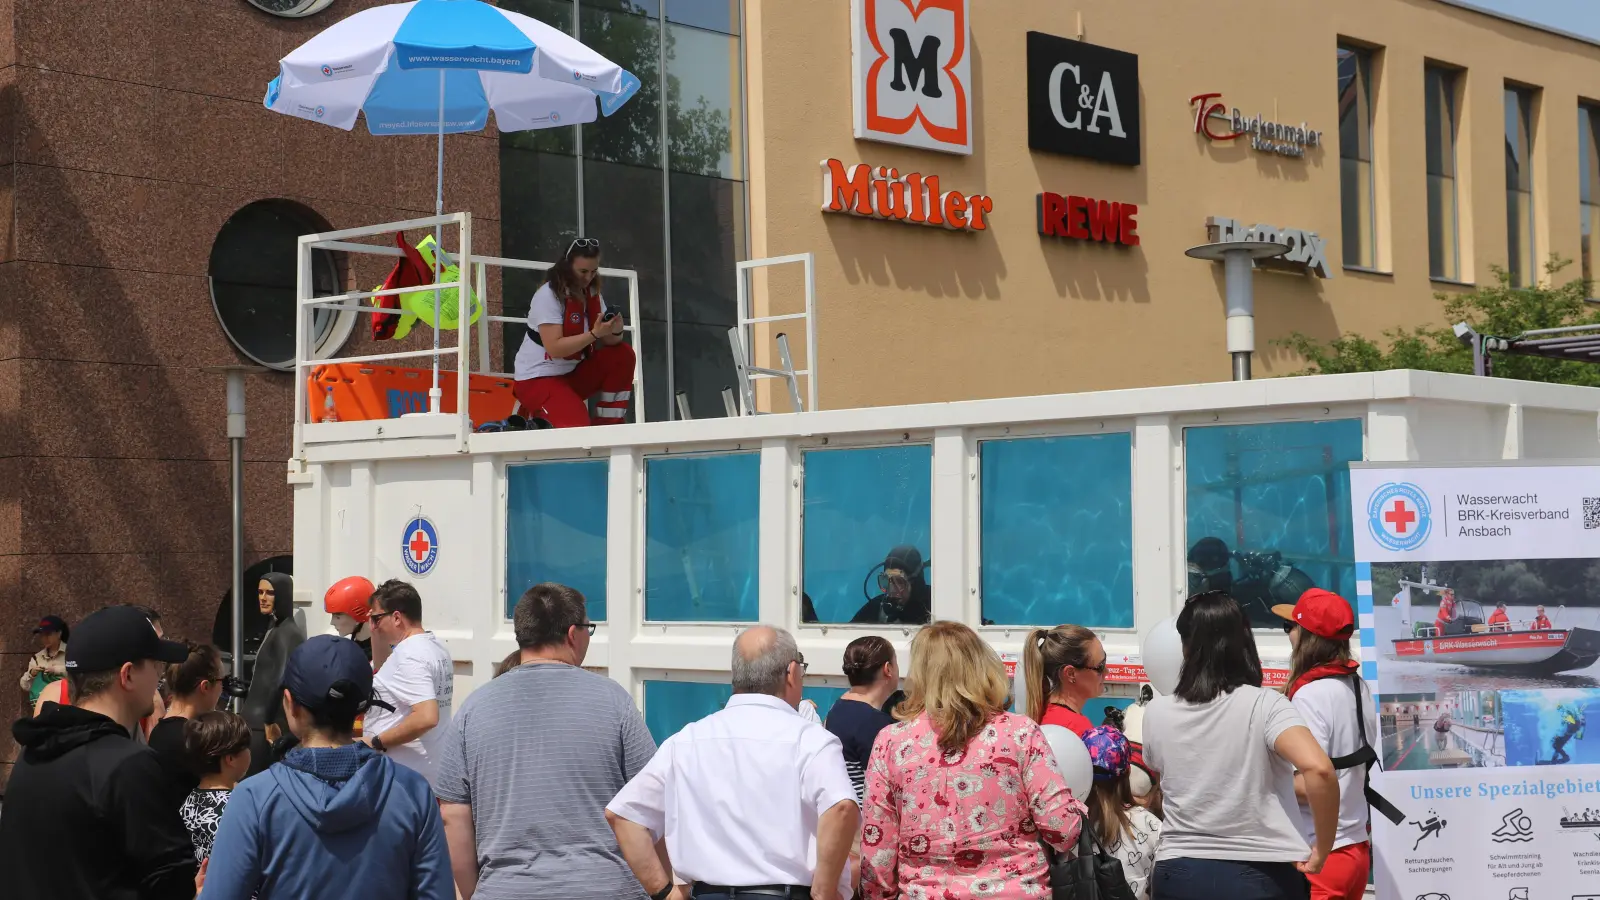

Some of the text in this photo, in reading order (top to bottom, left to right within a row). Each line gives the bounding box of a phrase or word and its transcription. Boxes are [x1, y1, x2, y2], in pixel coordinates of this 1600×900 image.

[408, 55, 521, 67] www.wasserwacht.bayern
[889, 27, 943, 99] M
[1048, 61, 1127, 139] C&A
[1231, 108, 1323, 146] Buckenmaier
[821, 157, 993, 231] Müller
[1037, 191, 1140, 246] REWE
[1457, 493, 1538, 506] Wasserwacht
[1458, 508, 1569, 522] BRK-Kreisverband
[1458, 526, 1512, 538] Ansbach
[1108, 667, 1136, 676] euz-Tag
[1410, 784, 1472, 800] Unsere
[1404, 856, 1455, 864] Rettungstauchen,
[1489, 853, 1541, 861] Schwimmtraining
